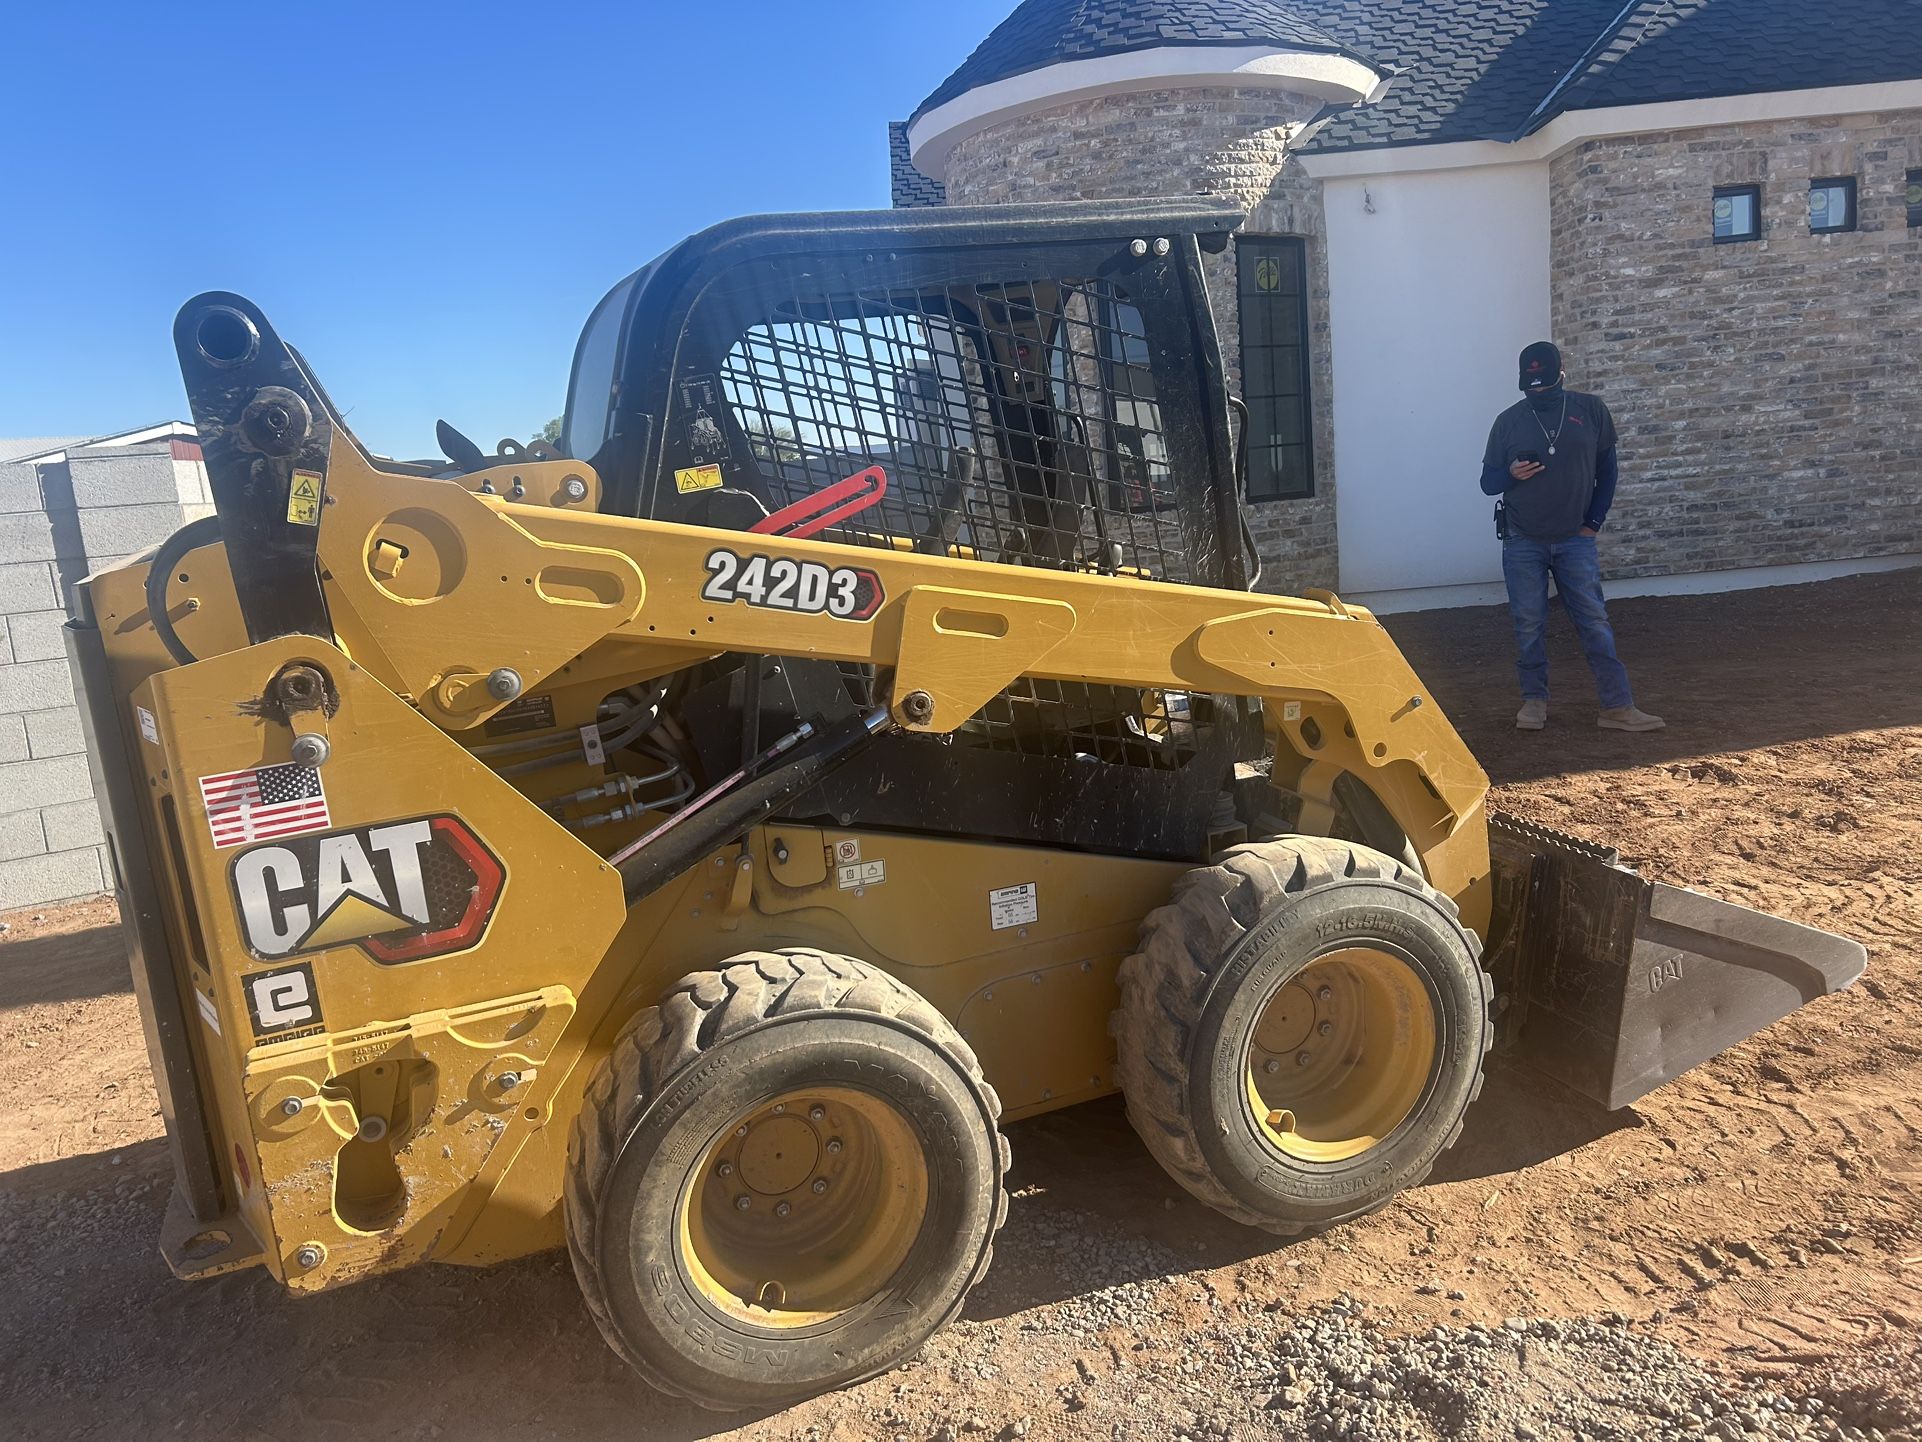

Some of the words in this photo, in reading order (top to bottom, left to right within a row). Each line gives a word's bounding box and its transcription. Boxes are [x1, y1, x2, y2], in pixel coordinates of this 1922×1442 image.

[704, 551, 858, 615] 242D3
[235, 820, 432, 955] CAT
[1648, 953, 1684, 993] CAT
